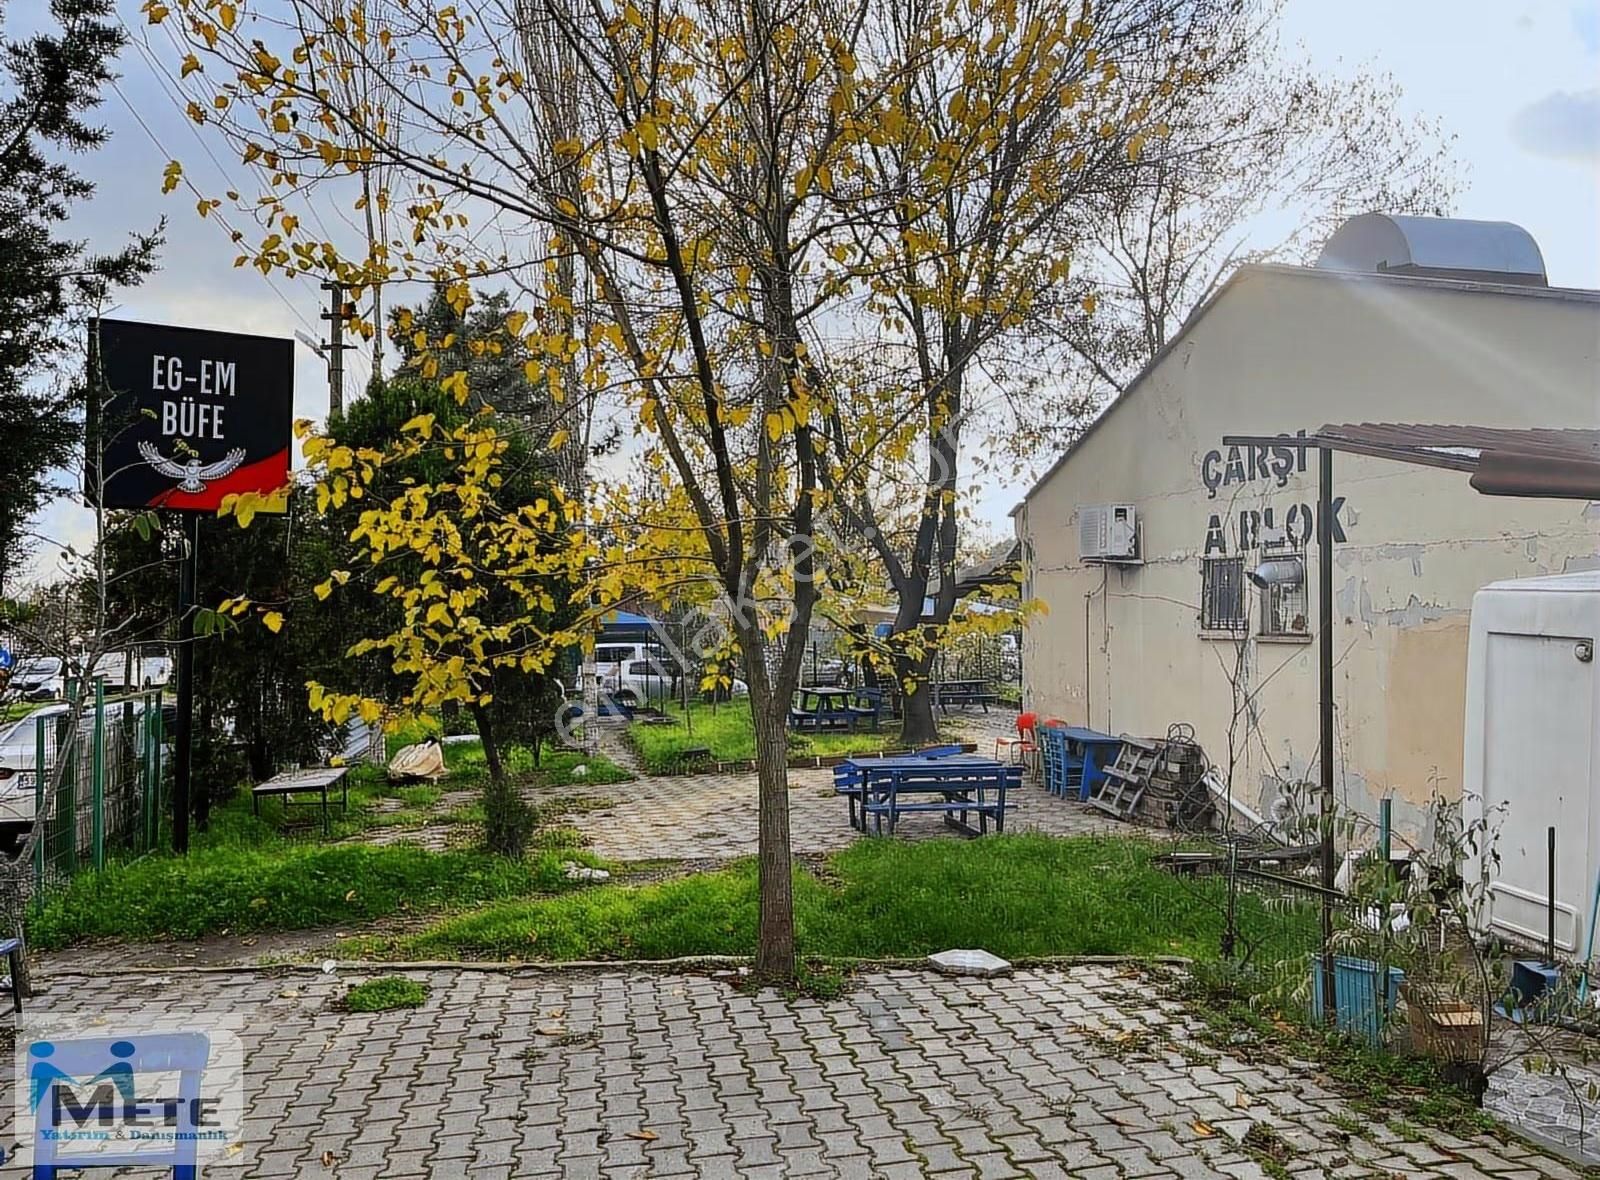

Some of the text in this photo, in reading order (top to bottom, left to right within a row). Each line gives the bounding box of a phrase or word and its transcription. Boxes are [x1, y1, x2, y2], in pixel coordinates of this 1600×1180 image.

[152, 355, 236, 396] EG-EM
[162, 396, 225, 439] BÜFE
[1204, 515, 1226, 554] A
